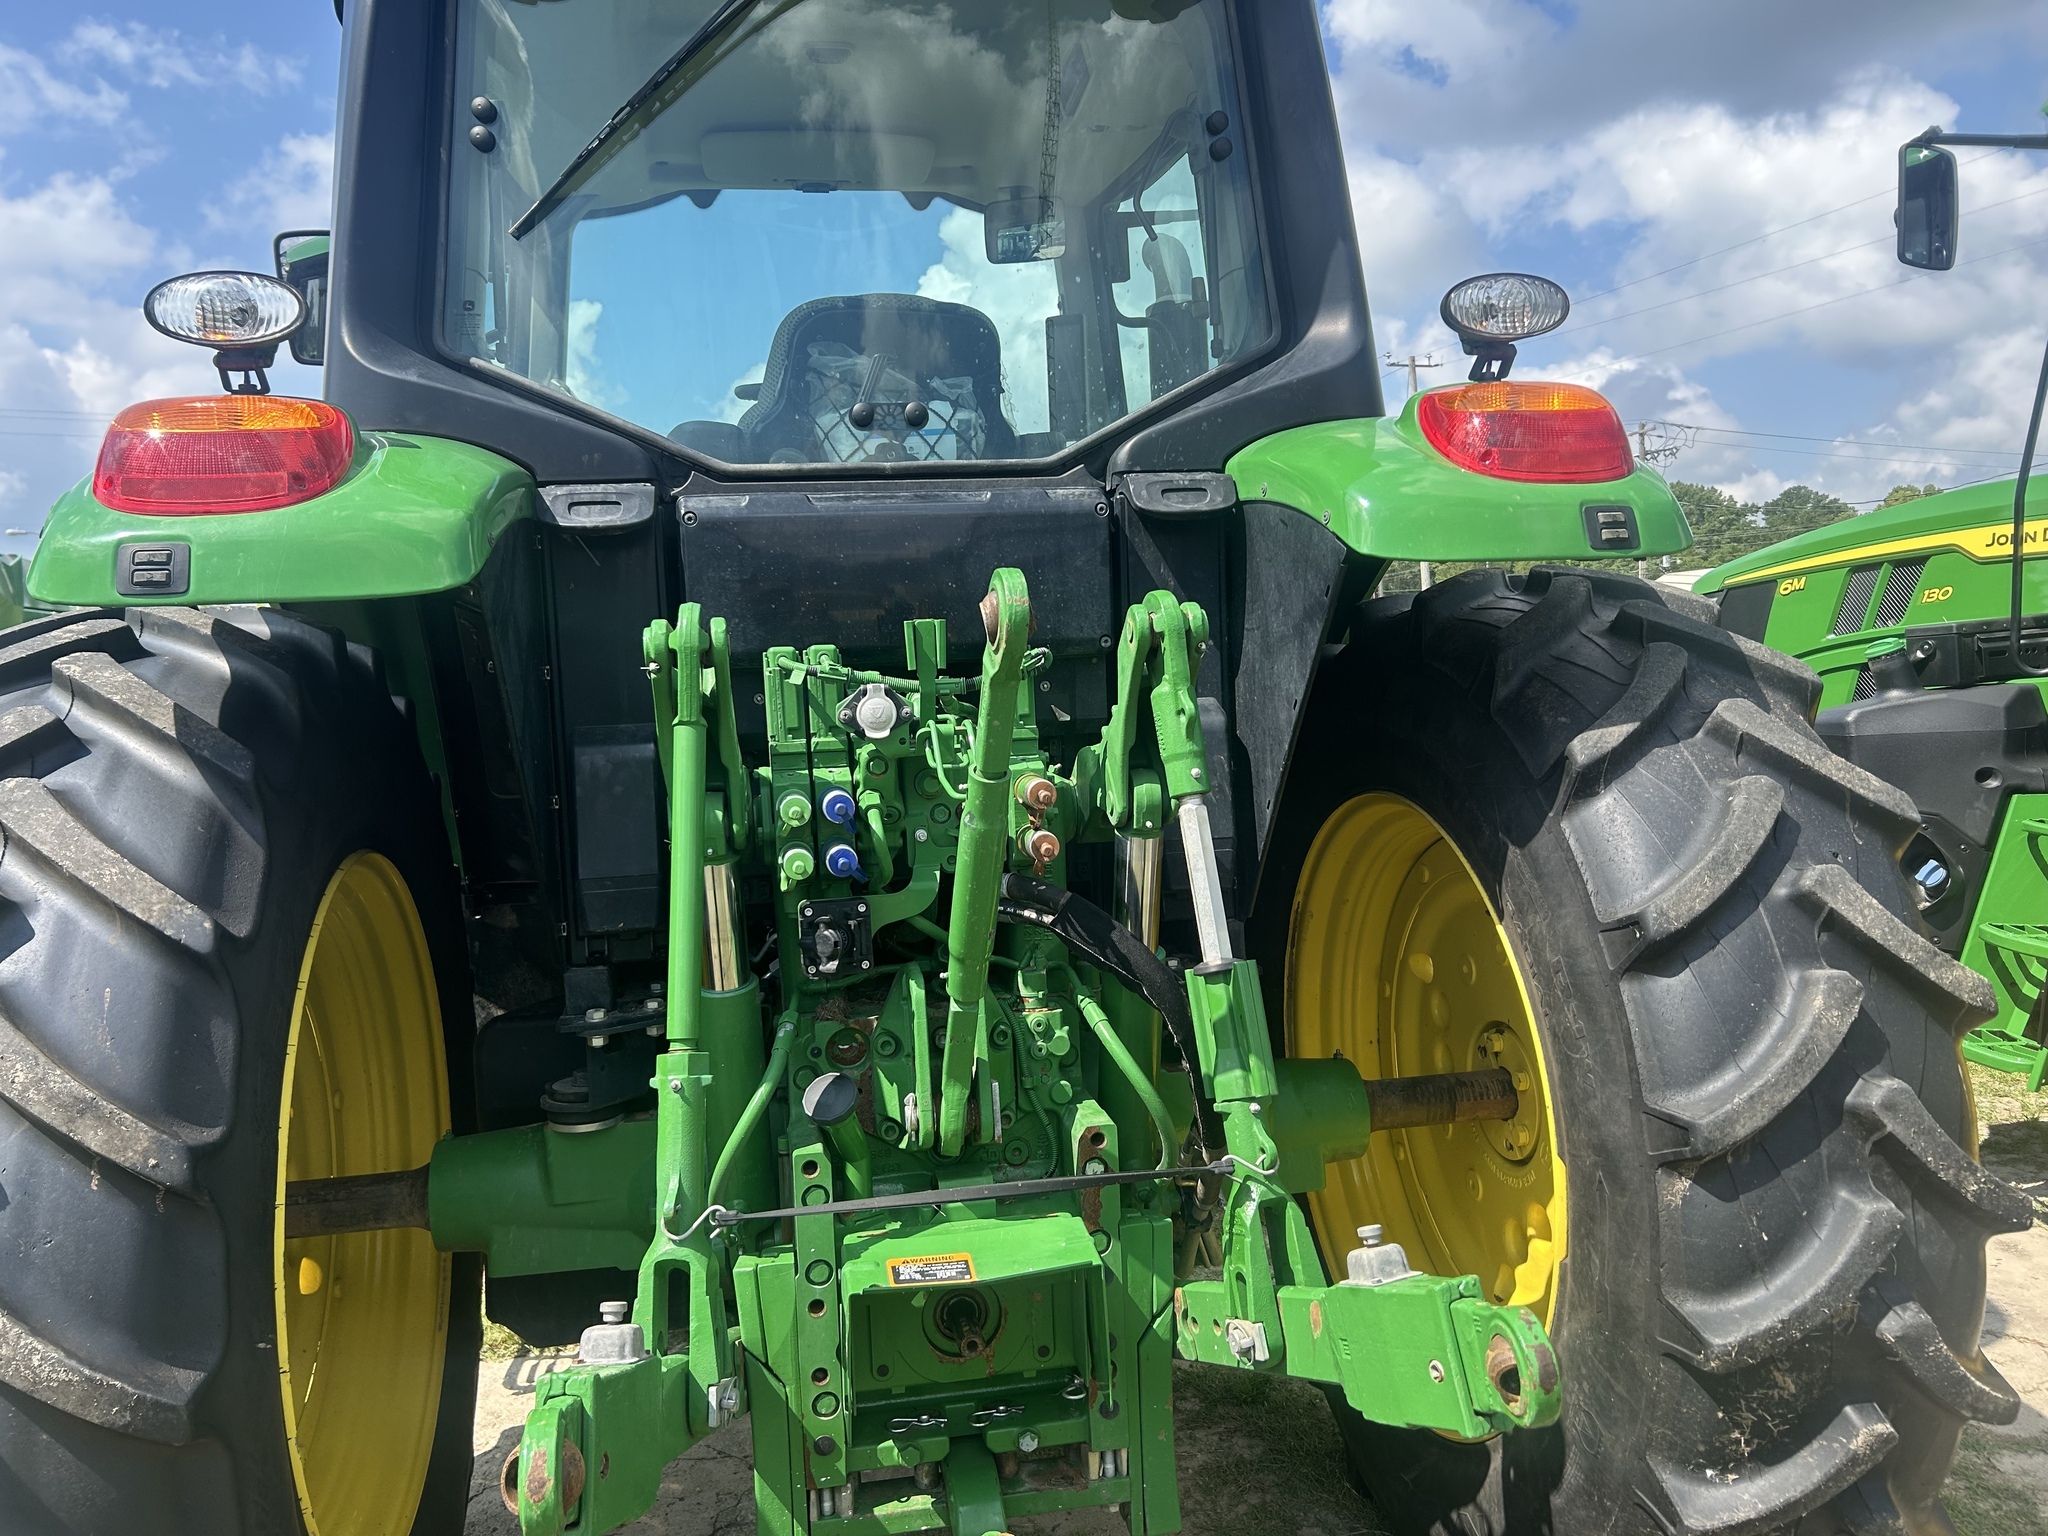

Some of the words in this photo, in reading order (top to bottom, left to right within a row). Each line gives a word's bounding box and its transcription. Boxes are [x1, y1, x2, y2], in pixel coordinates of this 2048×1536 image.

[1779, 576, 1807, 595] 6M
[1921, 586, 1953, 603] 130
[909, 1255, 954, 1264] WARNING
